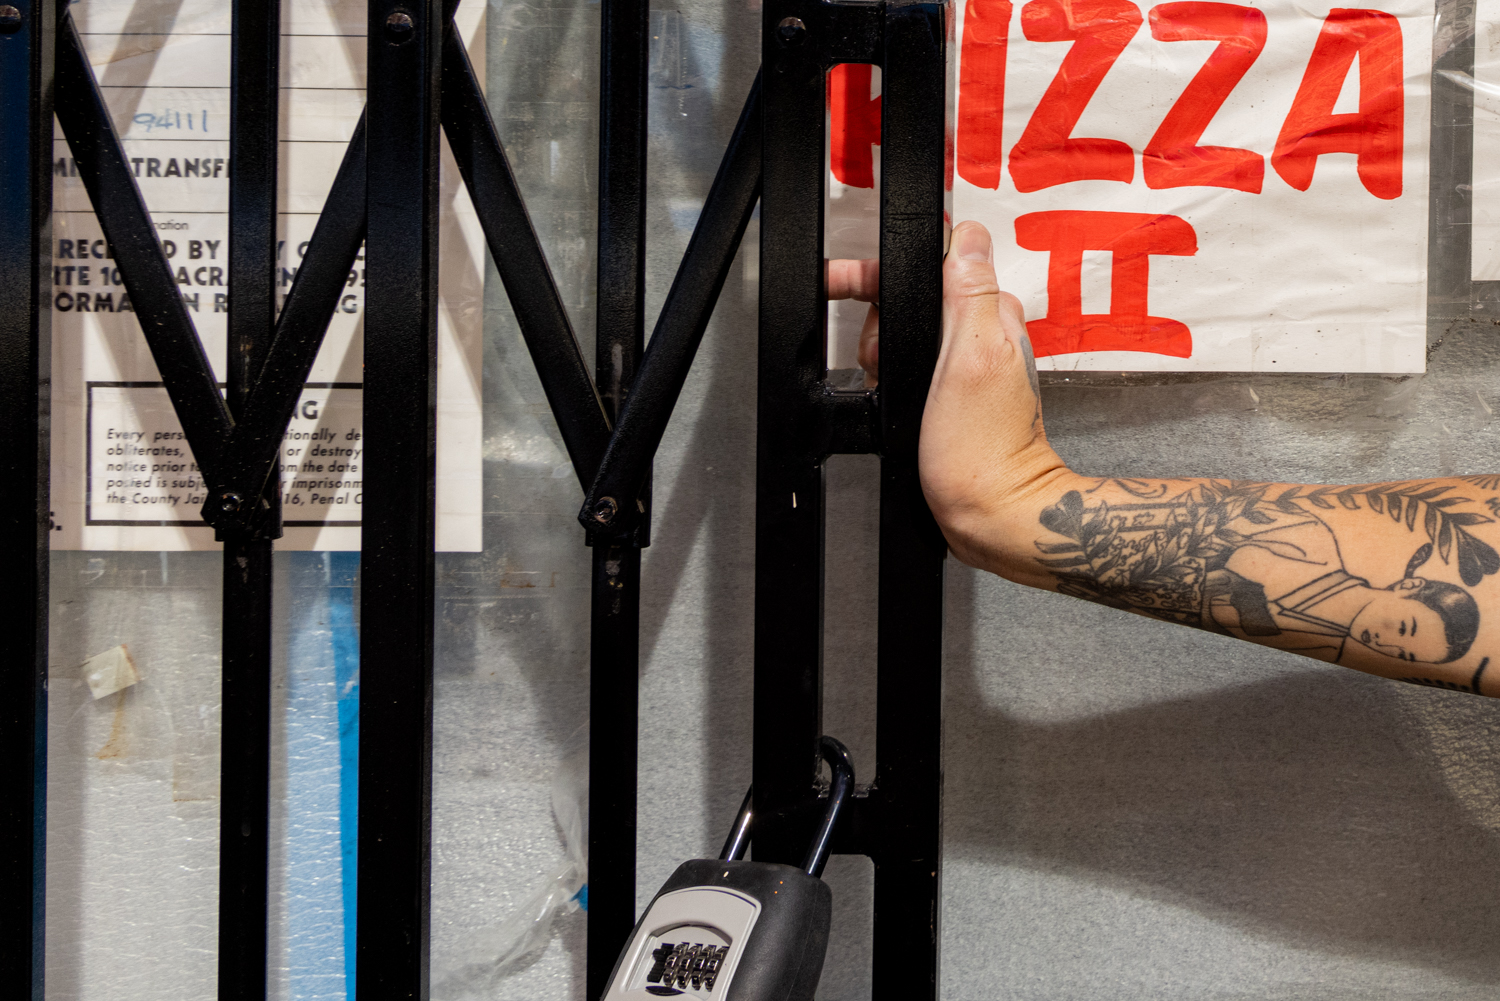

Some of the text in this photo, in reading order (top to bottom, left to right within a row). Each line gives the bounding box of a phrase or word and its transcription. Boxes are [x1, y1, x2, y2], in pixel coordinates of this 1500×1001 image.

[131, 157, 230, 178] TRANSF
[188, 239, 222, 260] BY
[106, 427, 145, 443] Every
[106, 443, 185, 458] obliterates,
[286, 447, 302, 457] or
[106, 462, 148, 472] notice
[151, 461, 186, 475] prior
[302, 460, 325, 473] the
[327, 459, 359, 473] date
[156, 477, 168, 488] is
[106, 491, 127, 504] the
[132, 492, 181, 507] County
[310, 492, 350, 505] Penal
